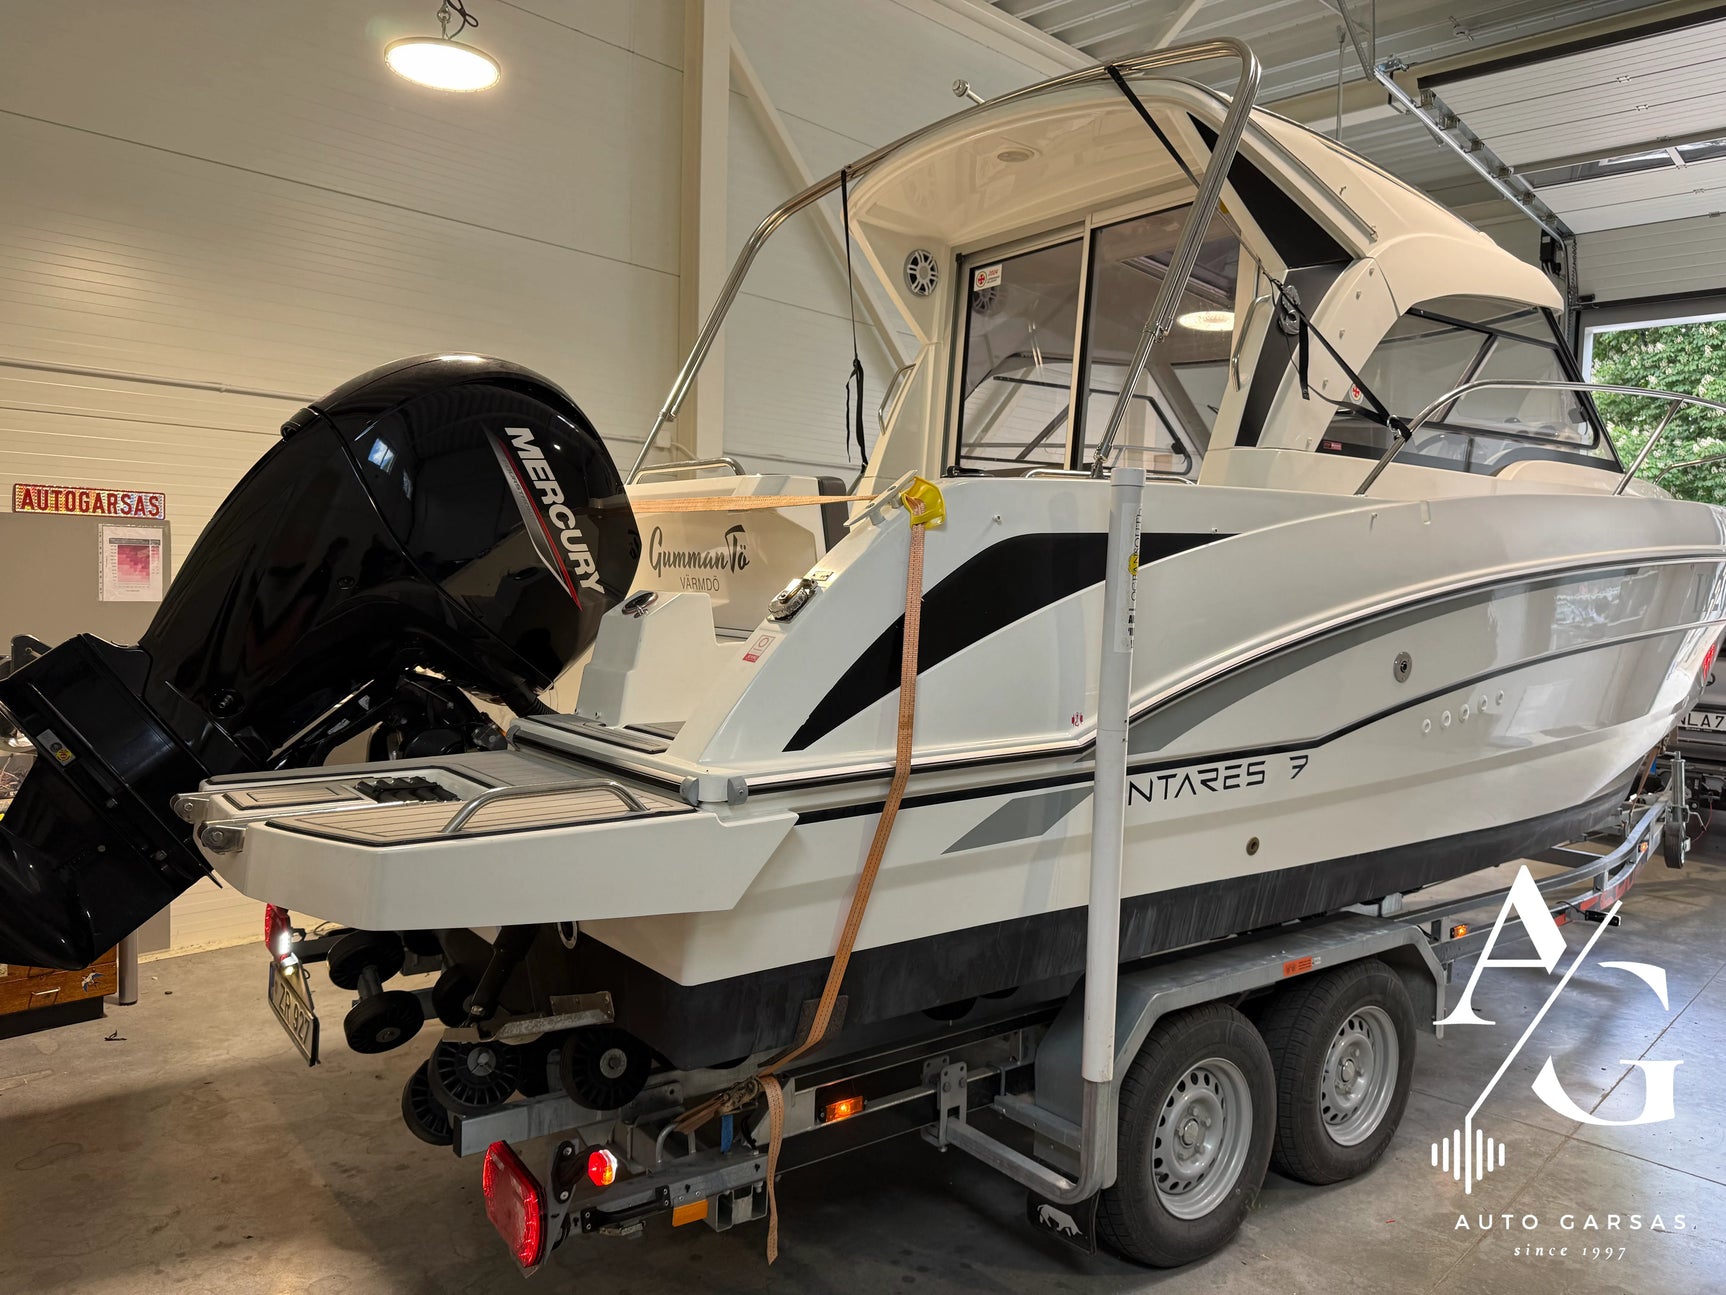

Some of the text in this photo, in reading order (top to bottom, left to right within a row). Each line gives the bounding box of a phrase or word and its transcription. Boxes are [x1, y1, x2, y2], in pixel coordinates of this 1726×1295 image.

[21, 487, 161, 517] AUTOGARSAS
[504, 427, 606, 594] MERCURY
[679, 575, 720, 592] VÄRMDÖ
[1127, 754, 1309, 806] NTARES 7
